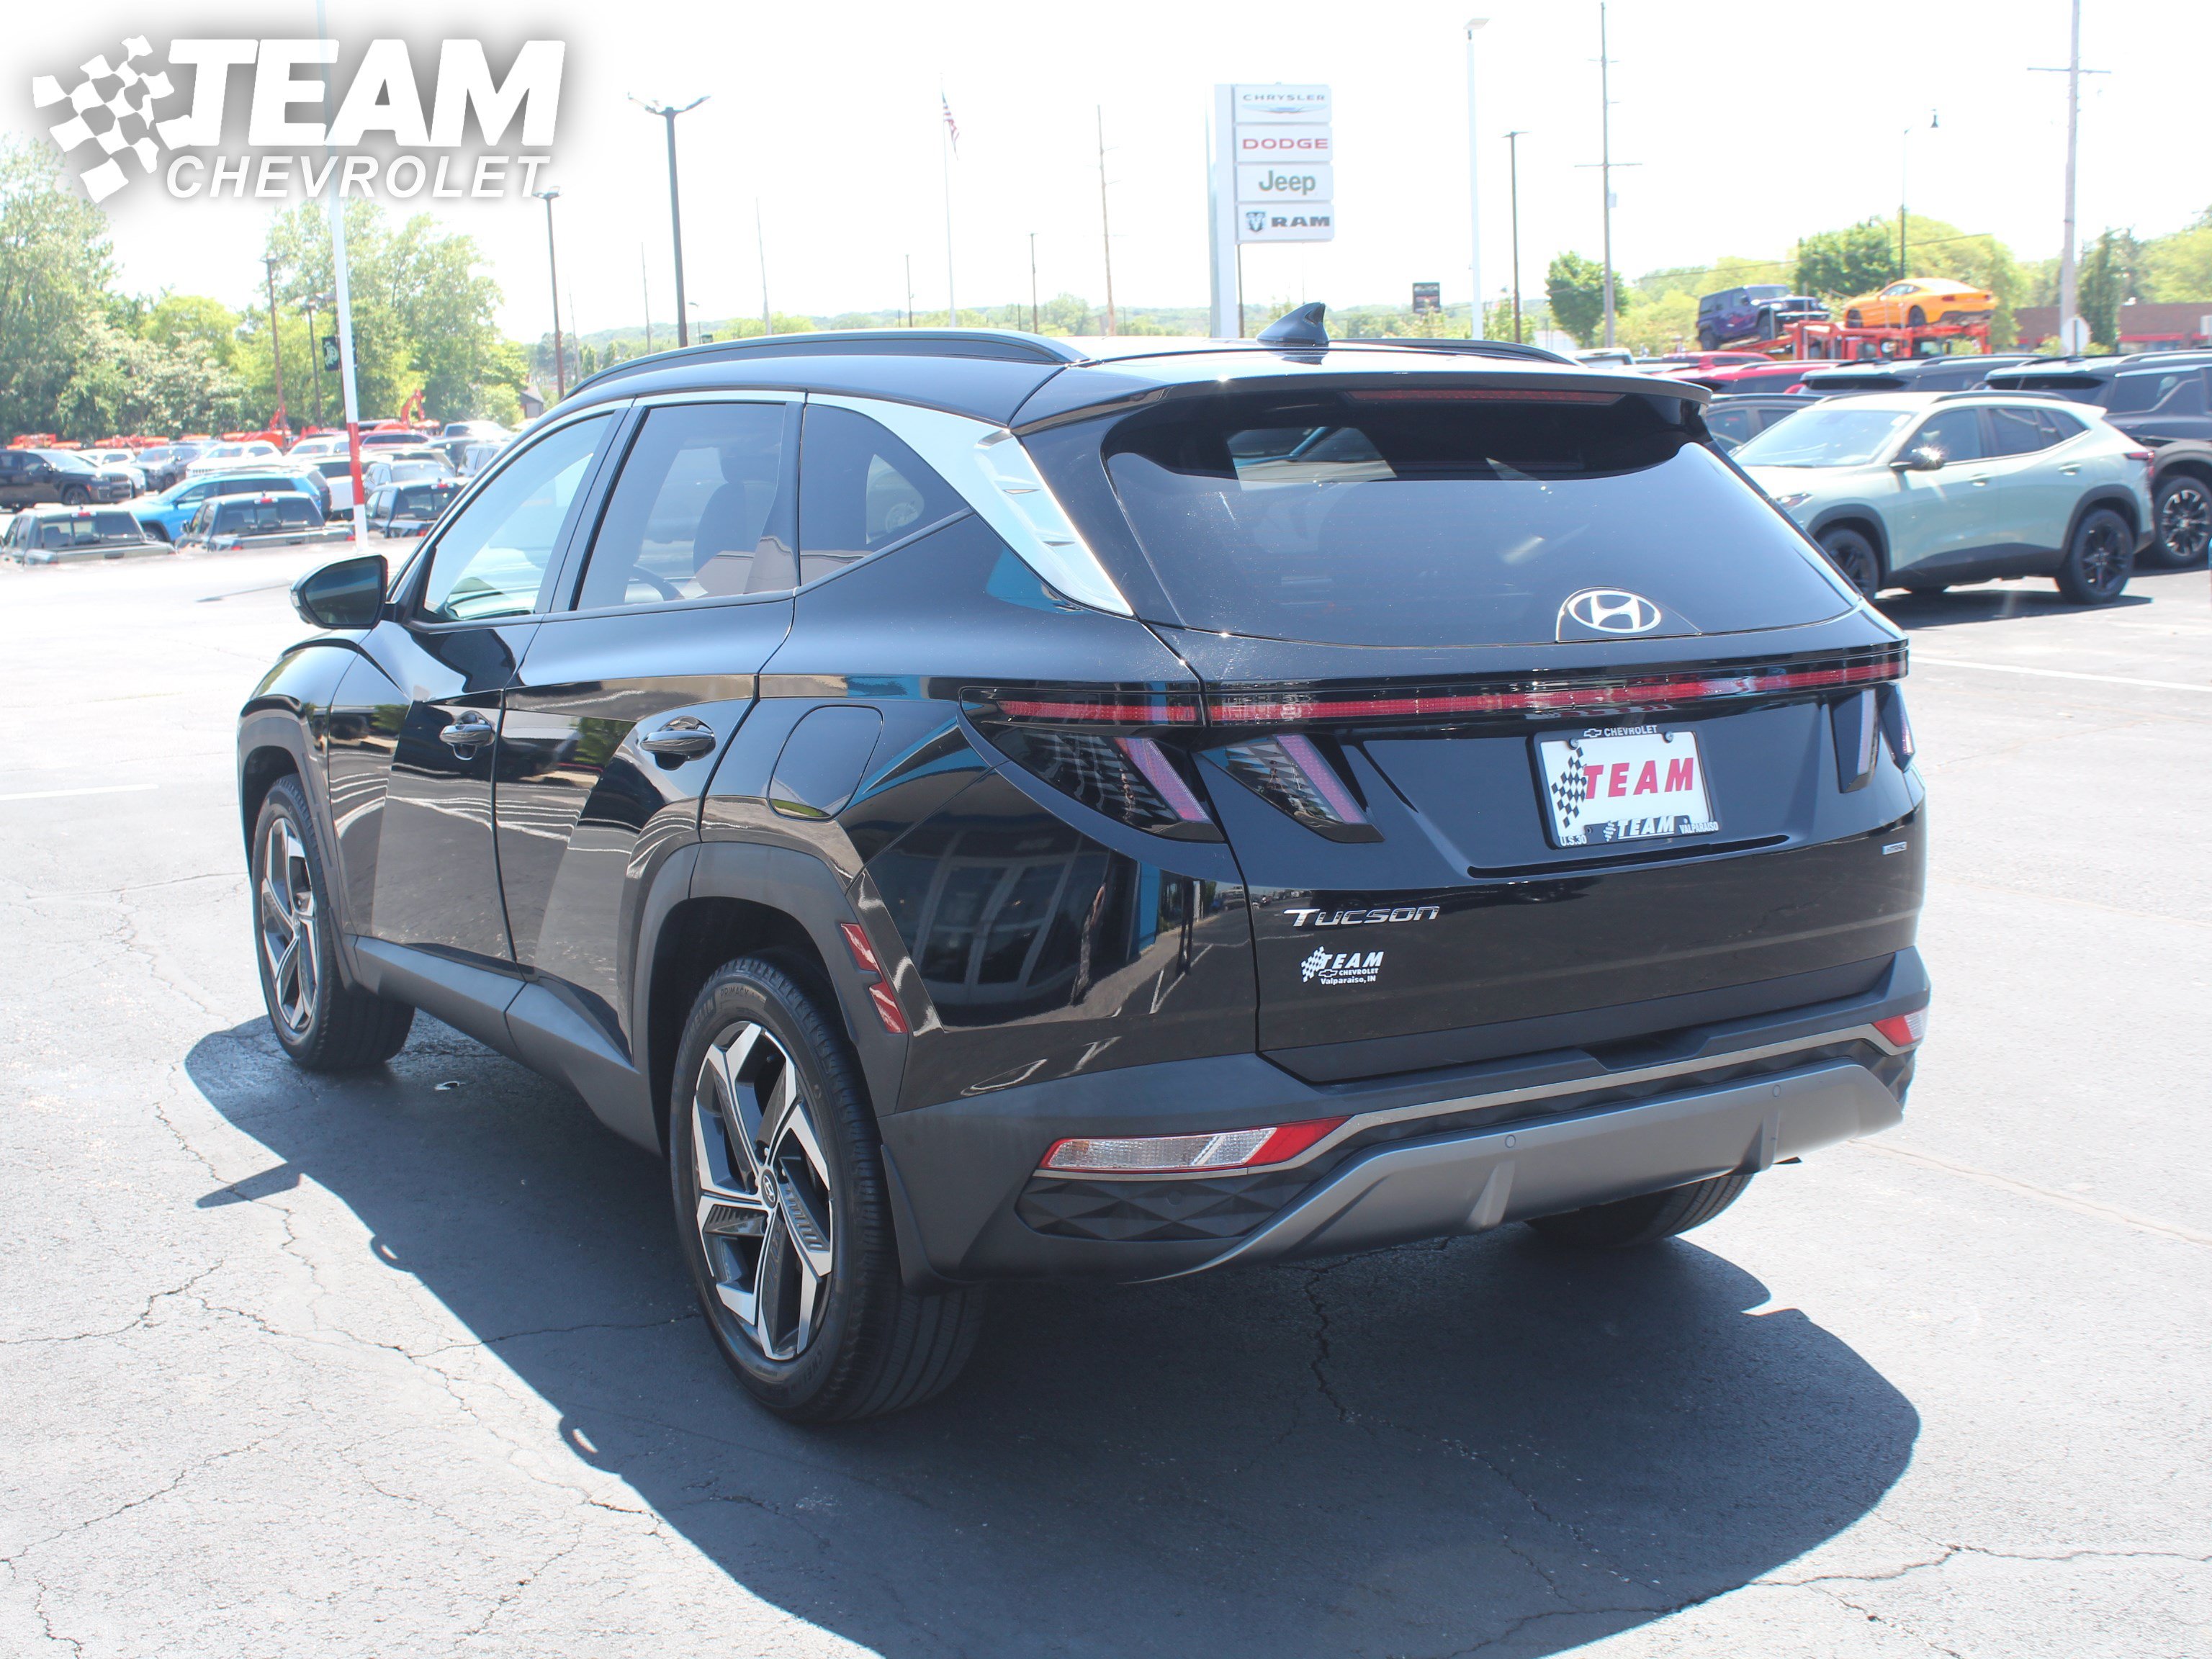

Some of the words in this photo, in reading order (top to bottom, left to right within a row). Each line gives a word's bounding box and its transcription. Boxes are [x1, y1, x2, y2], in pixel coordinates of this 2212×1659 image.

[1243, 139, 1328, 149] DODGE
[1259, 170, 1316, 196] Jeep
[1271, 217, 1330, 227] RAM
[1603, 725, 1658, 737] CHEVROLET
[1583, 757, 1694, 799] TEAM
[1617, 815, 1675, 837] TEAM
[1679, 822, 1719, 834] VALPARAISO
[1318, 951, 1384, 969] TEAM
[1320, 976, 1367, 985] Valparaiso,
